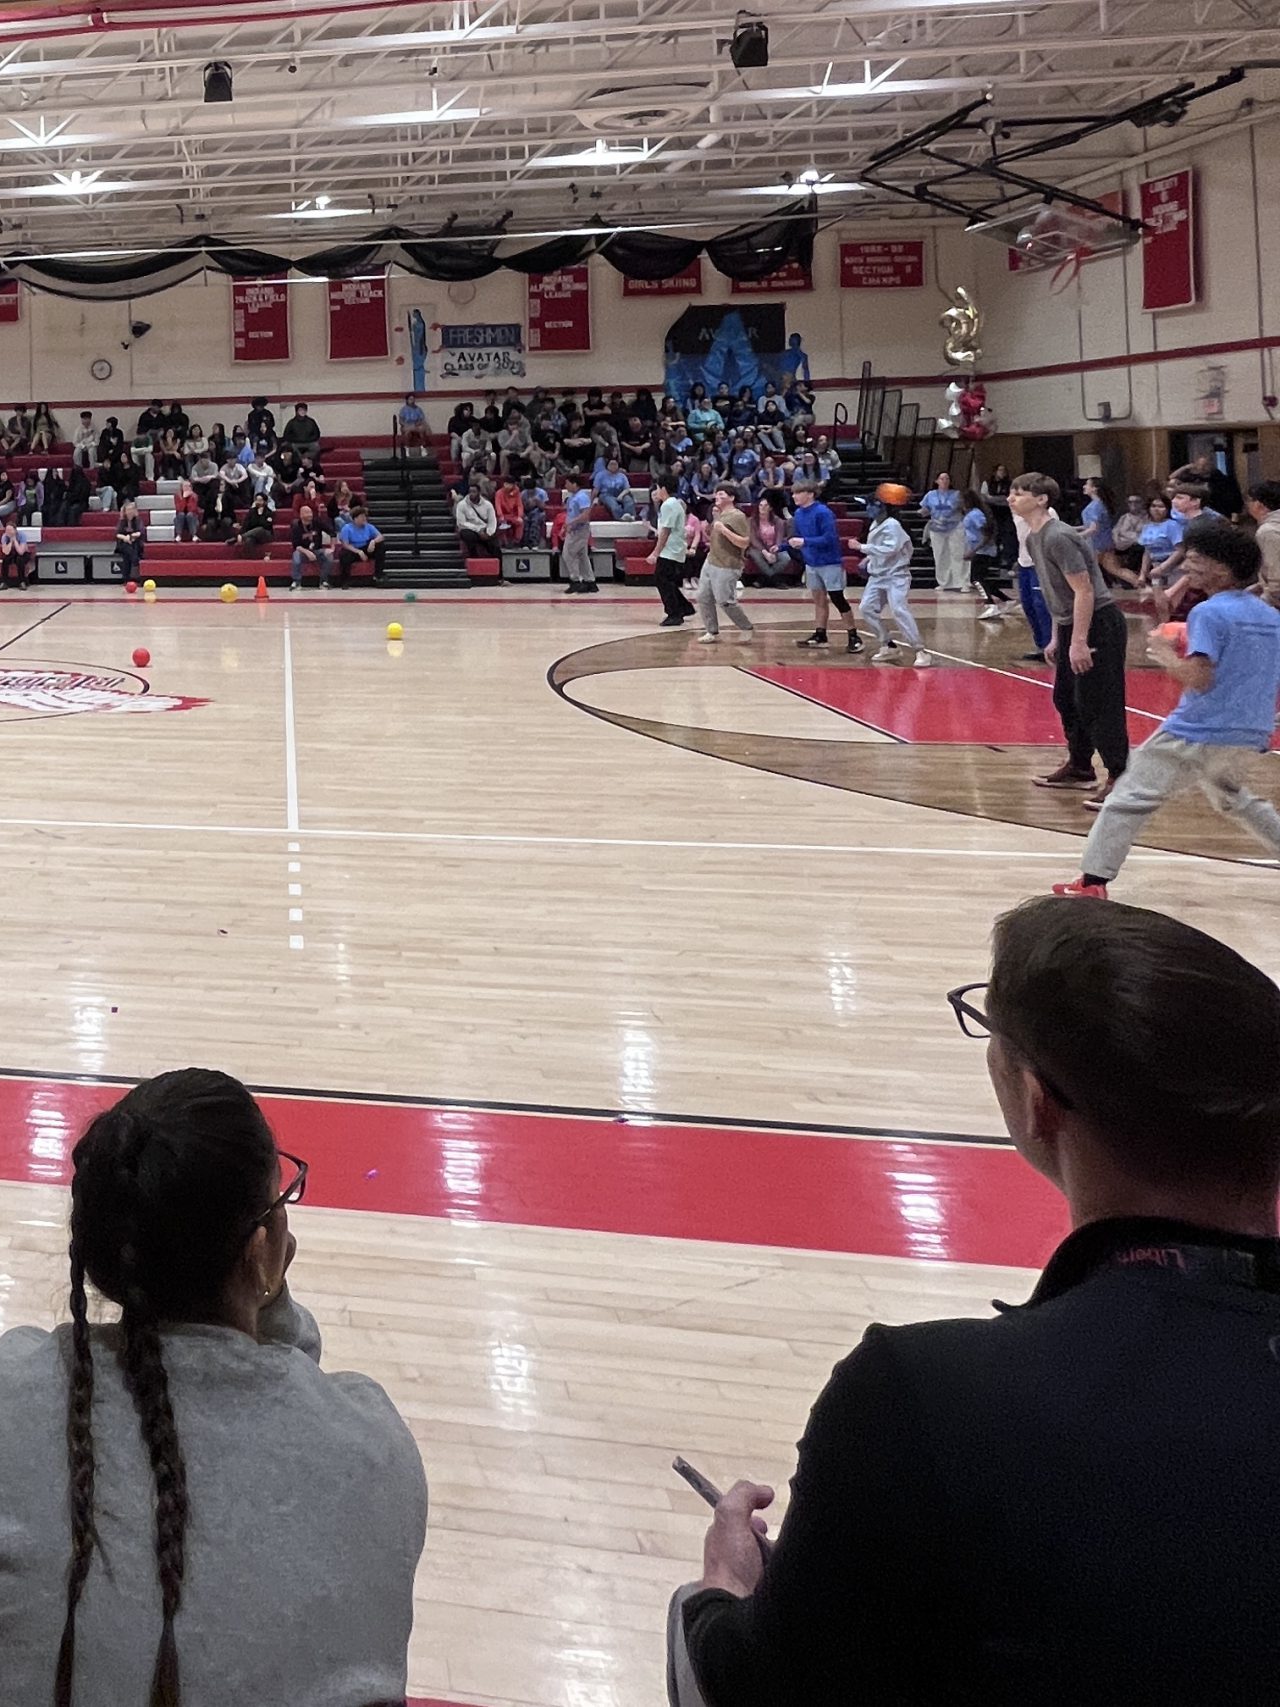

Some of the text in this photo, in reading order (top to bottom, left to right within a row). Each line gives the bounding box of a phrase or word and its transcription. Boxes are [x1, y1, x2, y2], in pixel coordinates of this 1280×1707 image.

[852, 266, 894, 275] SECTION
[628, 277, 697, 289] GIRLS SKIING
[449, 327, 516, 345] FRESHMEN
[698, 327, 760, 341] AVR
[457, 351, 512, 363] AVATAR
[444, 362, 475, 371] CLASS
